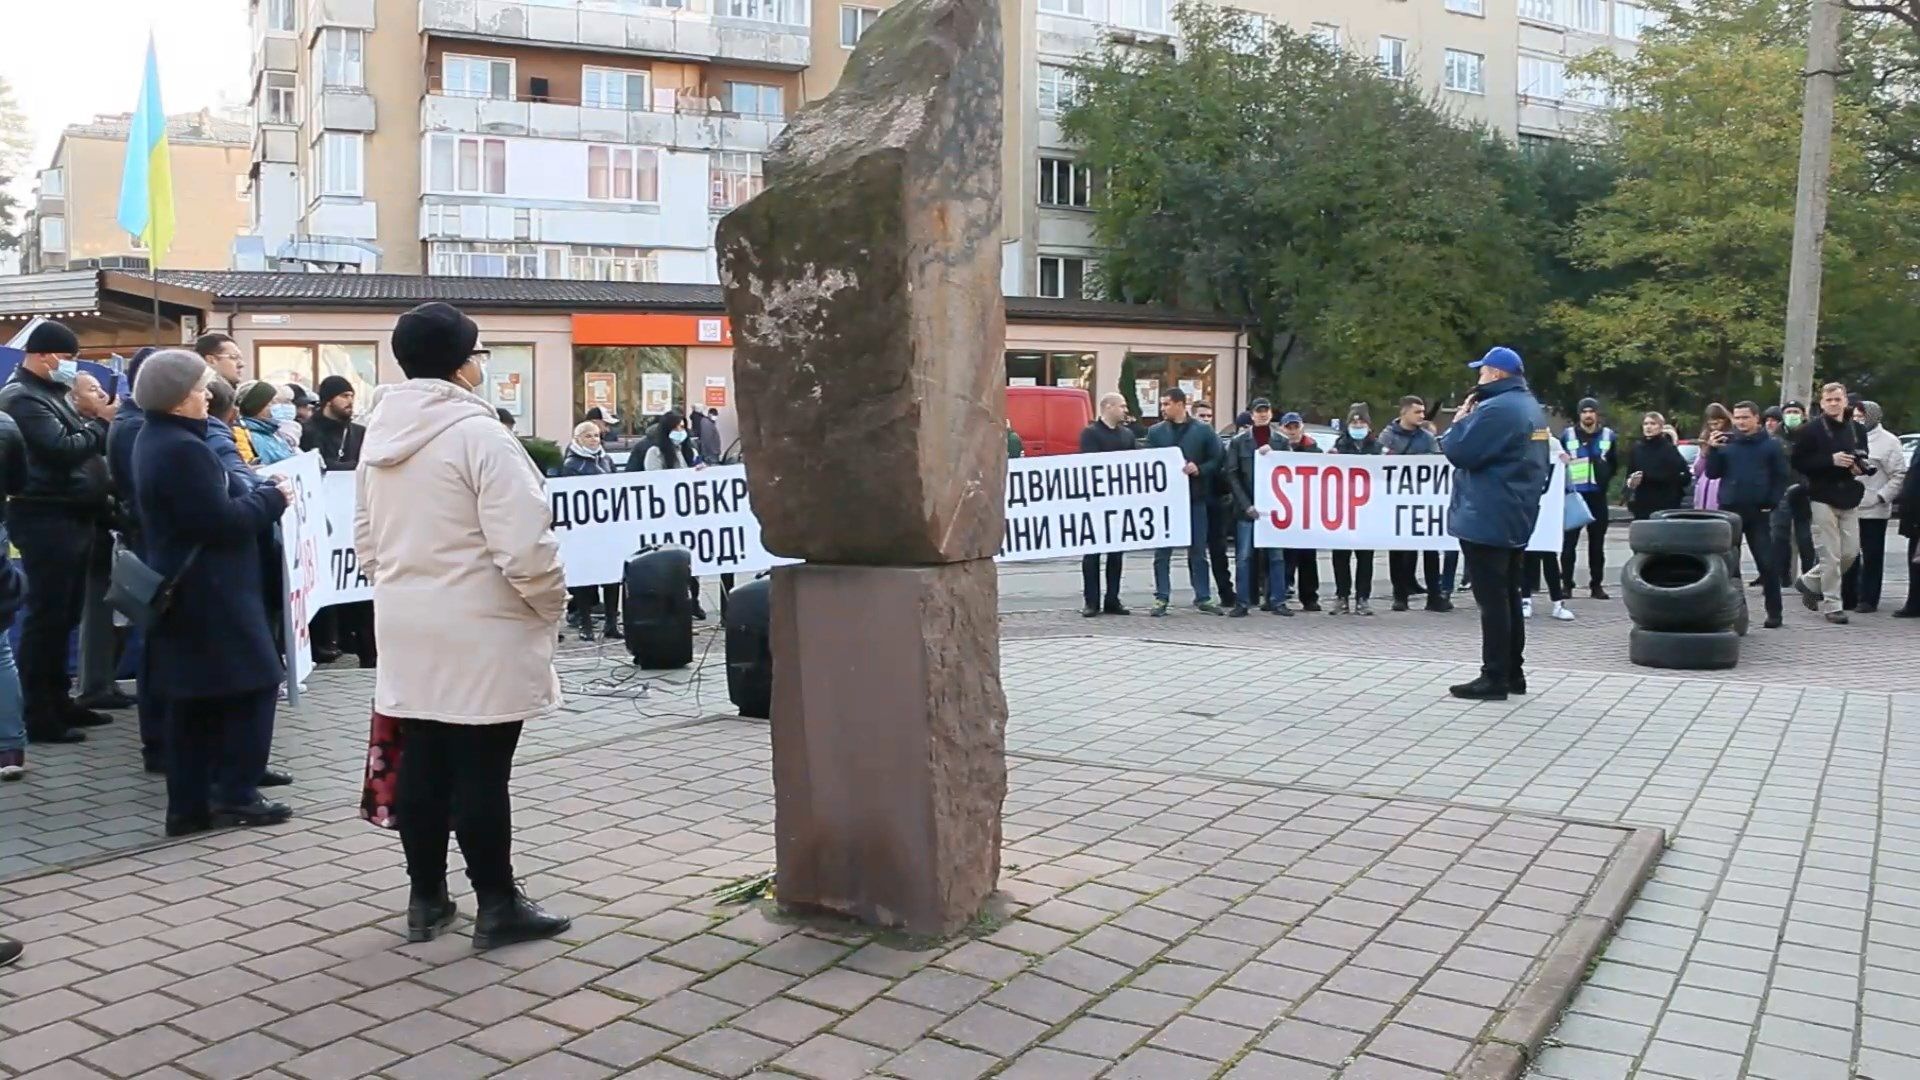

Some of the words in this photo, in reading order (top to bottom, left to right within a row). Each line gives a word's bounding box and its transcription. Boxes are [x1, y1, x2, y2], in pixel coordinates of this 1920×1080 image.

[550, 484, 666, 531] ДОСИТЬ
[1270, 465, 1372, 531] STOP
[999, 515, 1052, 557] ІНИ
[1059, 512, 1097, 548] НА
[331, 548, 375, 591] ПРА
